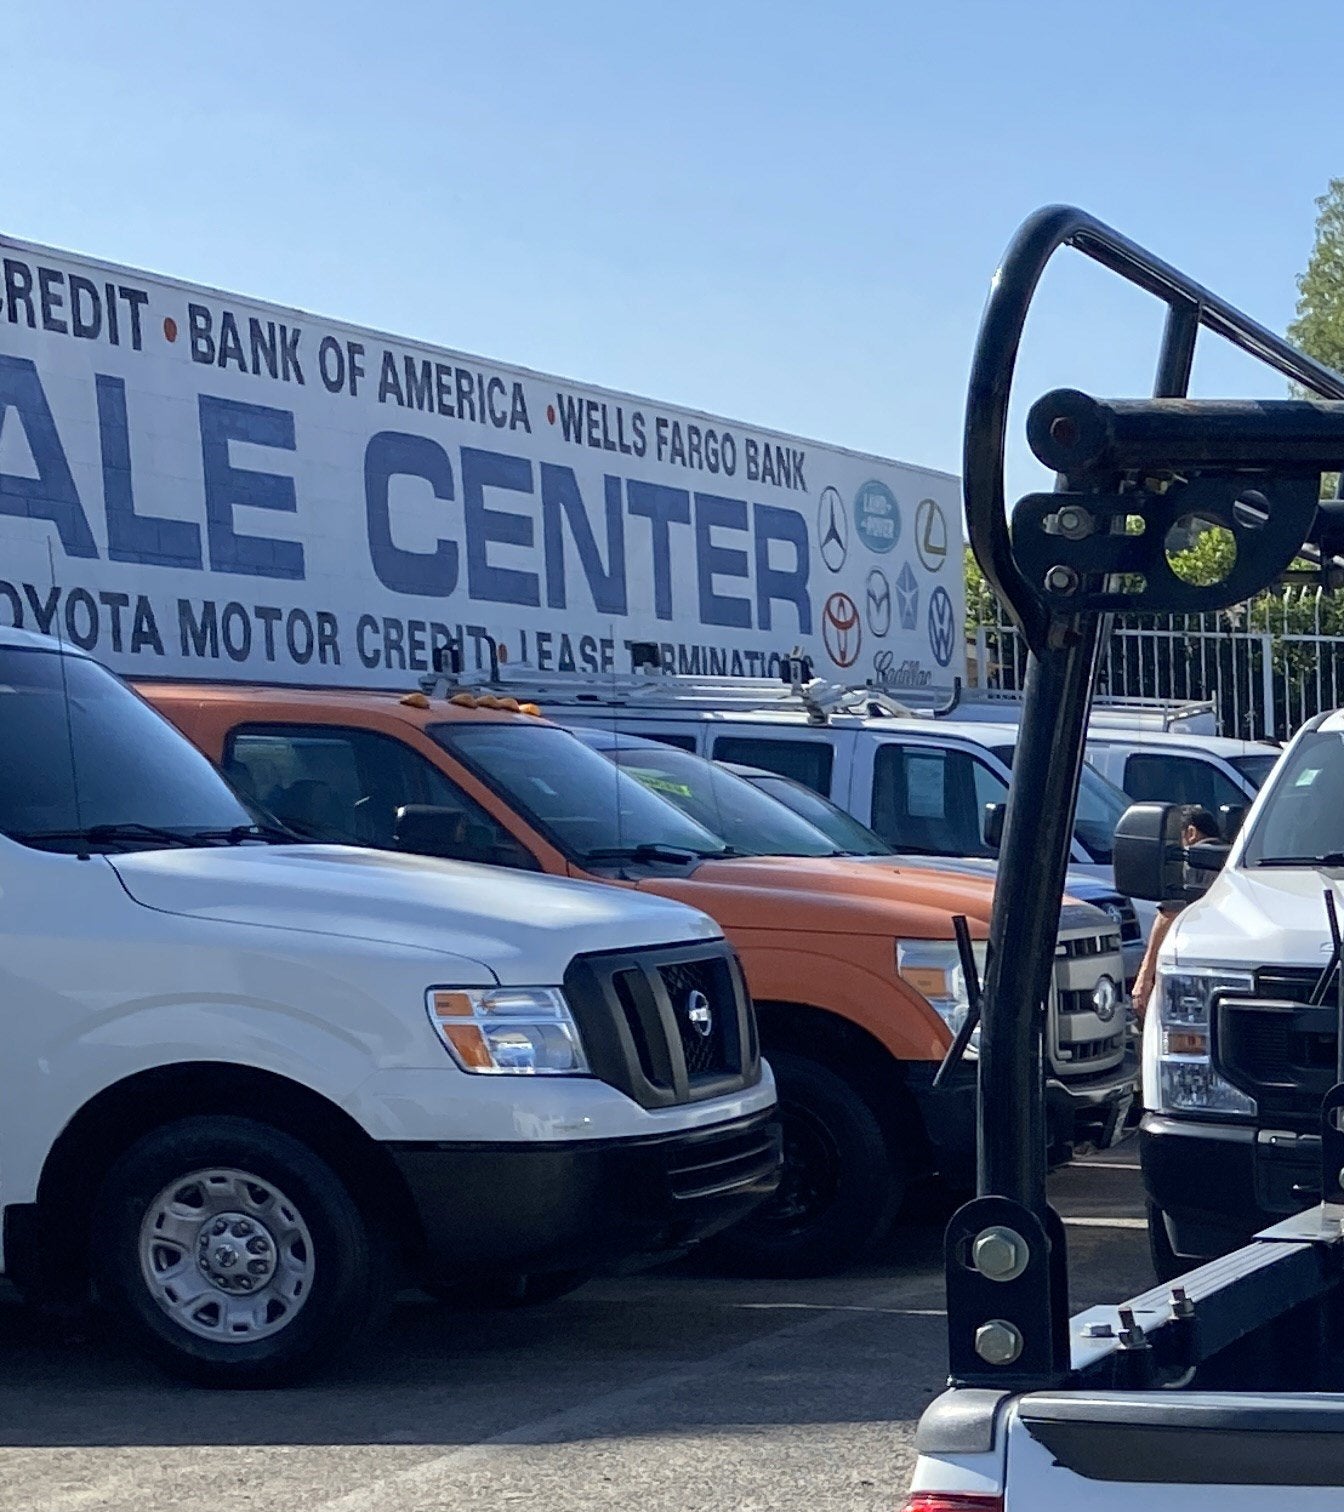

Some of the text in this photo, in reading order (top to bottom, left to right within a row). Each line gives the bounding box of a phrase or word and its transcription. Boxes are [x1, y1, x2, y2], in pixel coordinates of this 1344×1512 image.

[0, 258, 808, 493] REDIT BANK OF AMERICA WELLS FARGO BANK
[178, 599, 341, 665] MOTOR
[363, 430, 813, 635] CENTER
